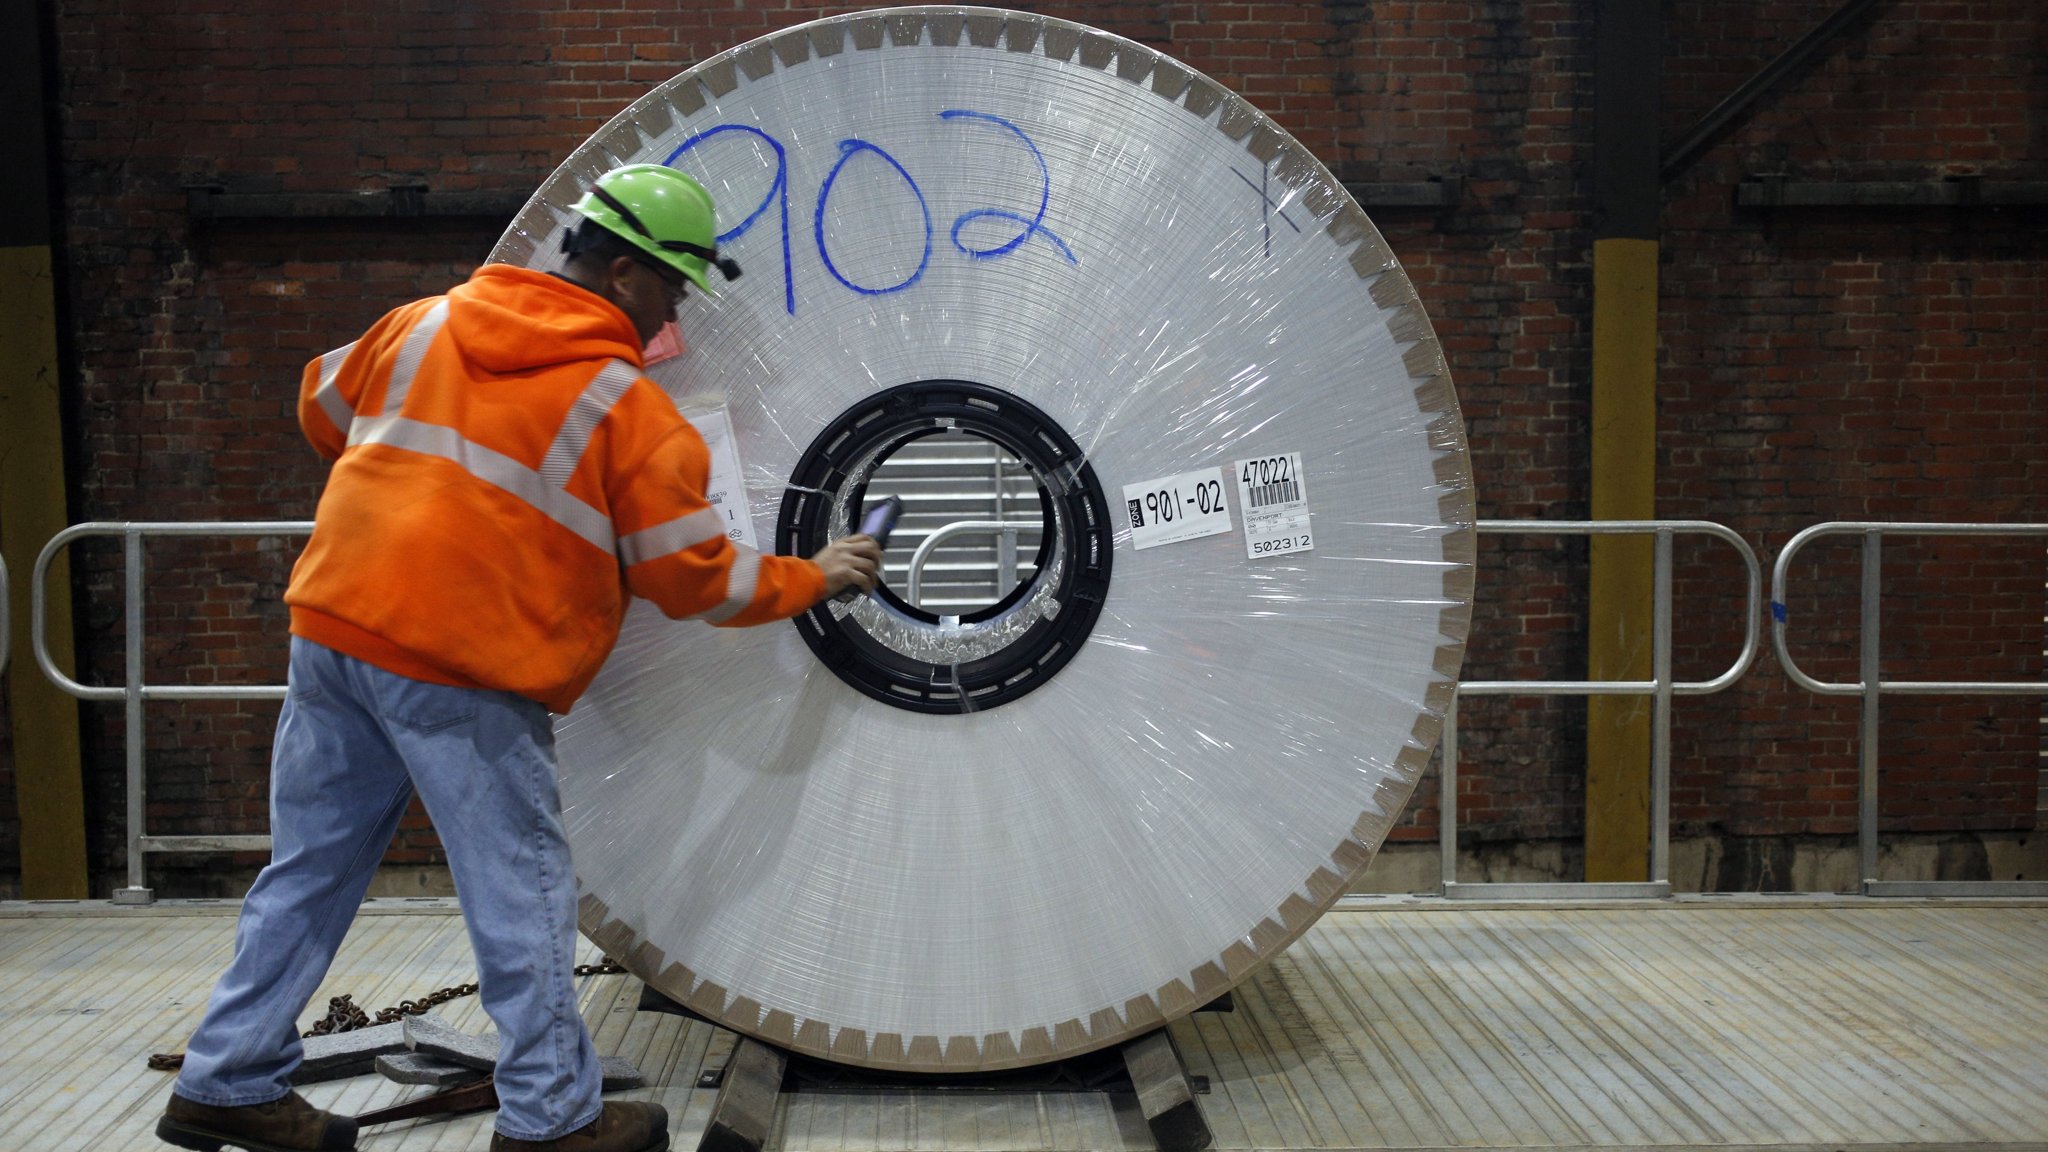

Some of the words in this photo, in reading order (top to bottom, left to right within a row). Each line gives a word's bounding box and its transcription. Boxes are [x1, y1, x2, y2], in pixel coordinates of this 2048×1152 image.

[661, 109, 1077, 316] 902
[1242, 455, 1296, 487] 470221
[1128, 501, 1142, 527] ZONE
[1146, 480, 1224, 524] 901-02
[1246, 512, 1283, 523] DAVENPORT
[1254, 535, 1310, 554] 502312
